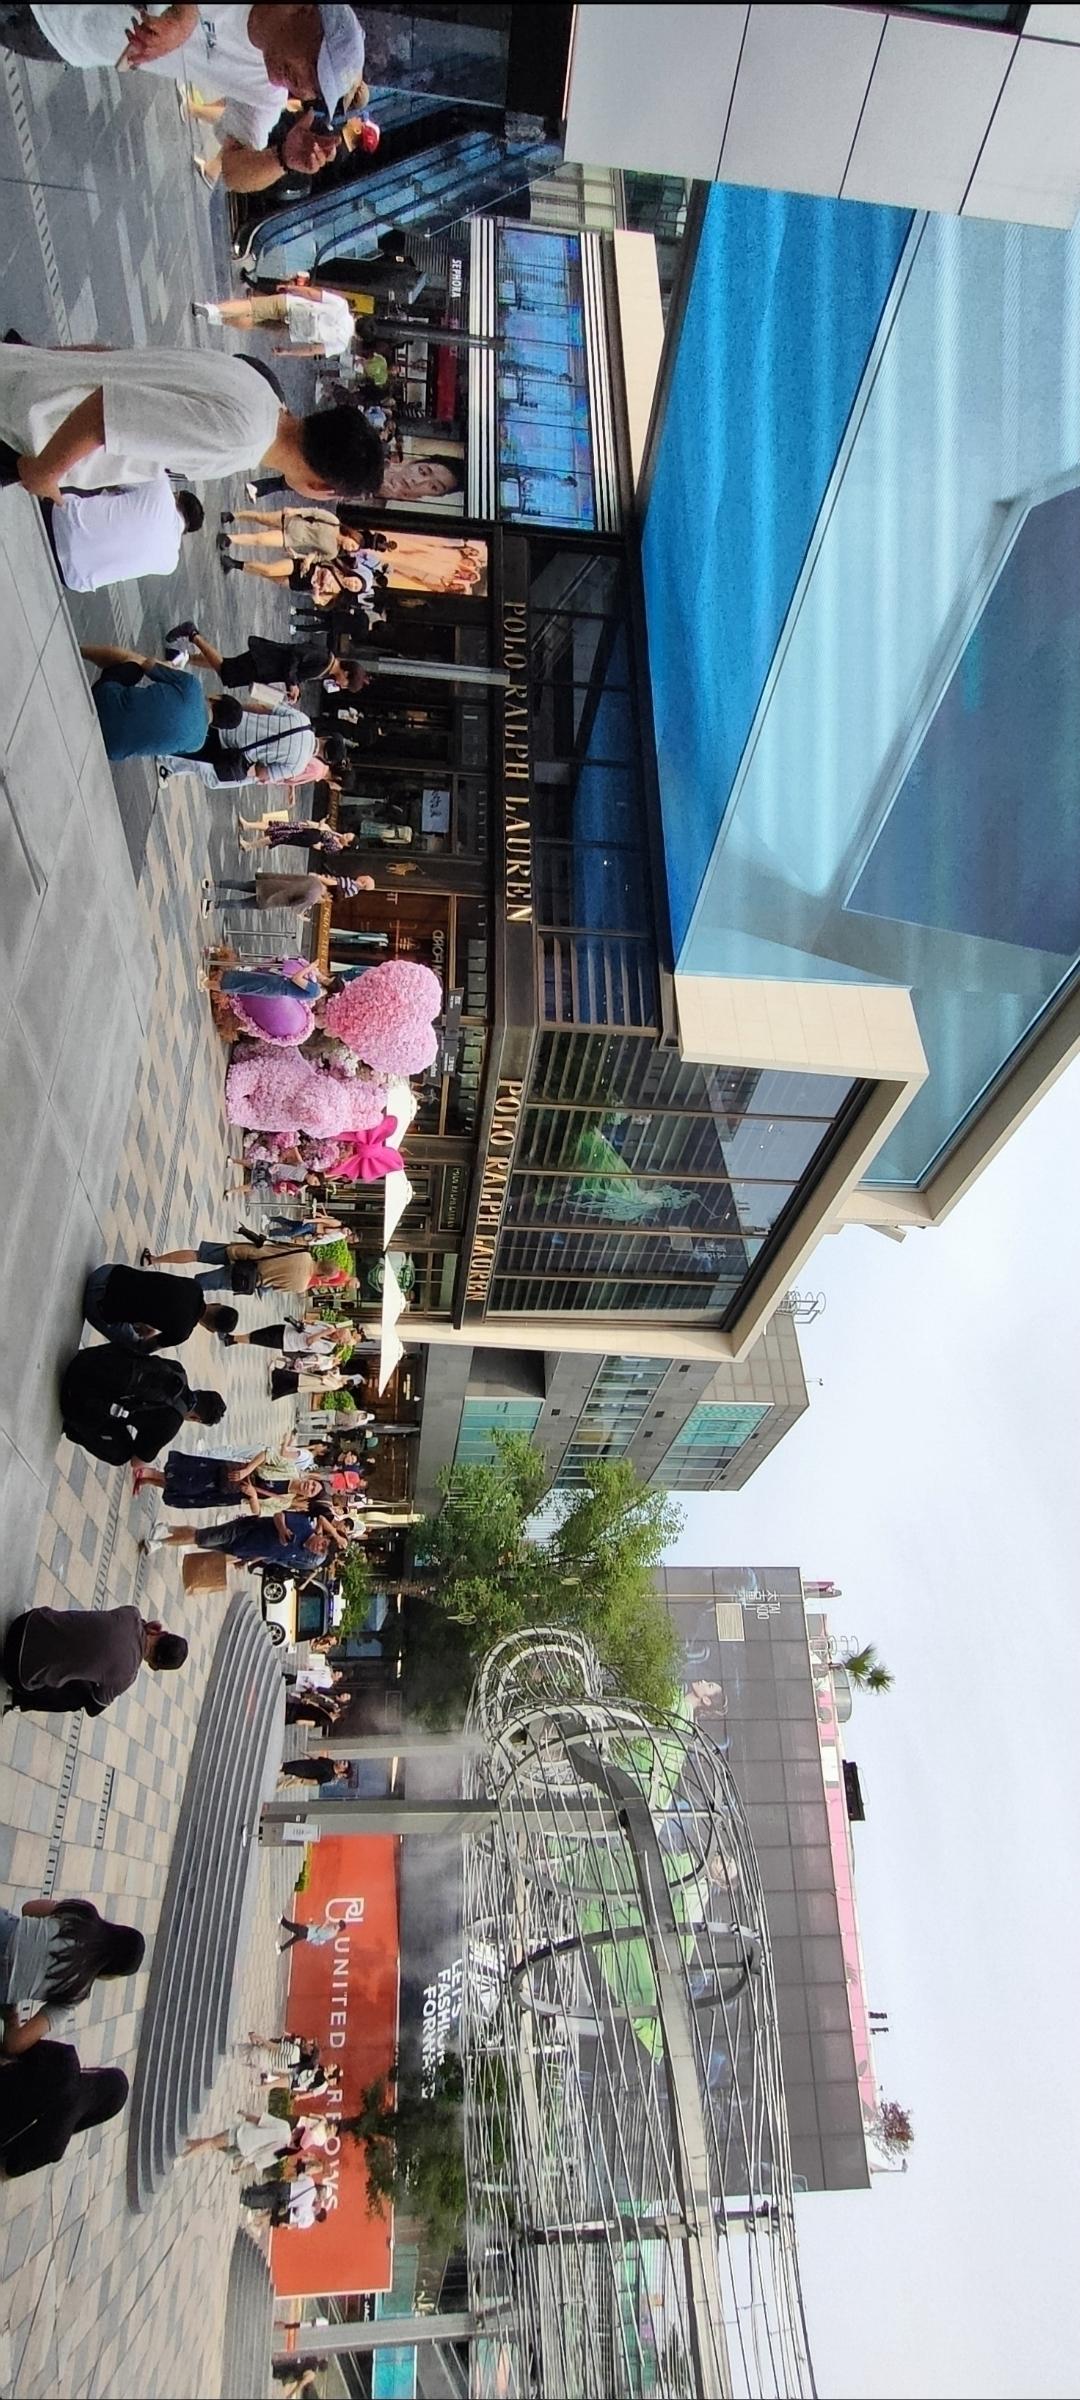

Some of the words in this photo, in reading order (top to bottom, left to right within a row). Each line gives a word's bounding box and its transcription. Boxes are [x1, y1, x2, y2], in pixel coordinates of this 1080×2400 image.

[450, 258, 462, 298] SEPHORA
[503, 600, 528, 669] POLO
[503, 683, 529, 780] RALPH
[505, 796, 533, 924] LAUREN
[489, 1078, 524, 1146] POLO
[477, 1155, 511, 1226] RALPH
[465, 1233, 497, 1301] LAUREN
[755, 1603, 769, 1620] KOO
[768, 1602, 781, 1614] TAI
[329, 1936, 351, 2049] UNITED
[321, 2069, 344, 2211] ROWS
